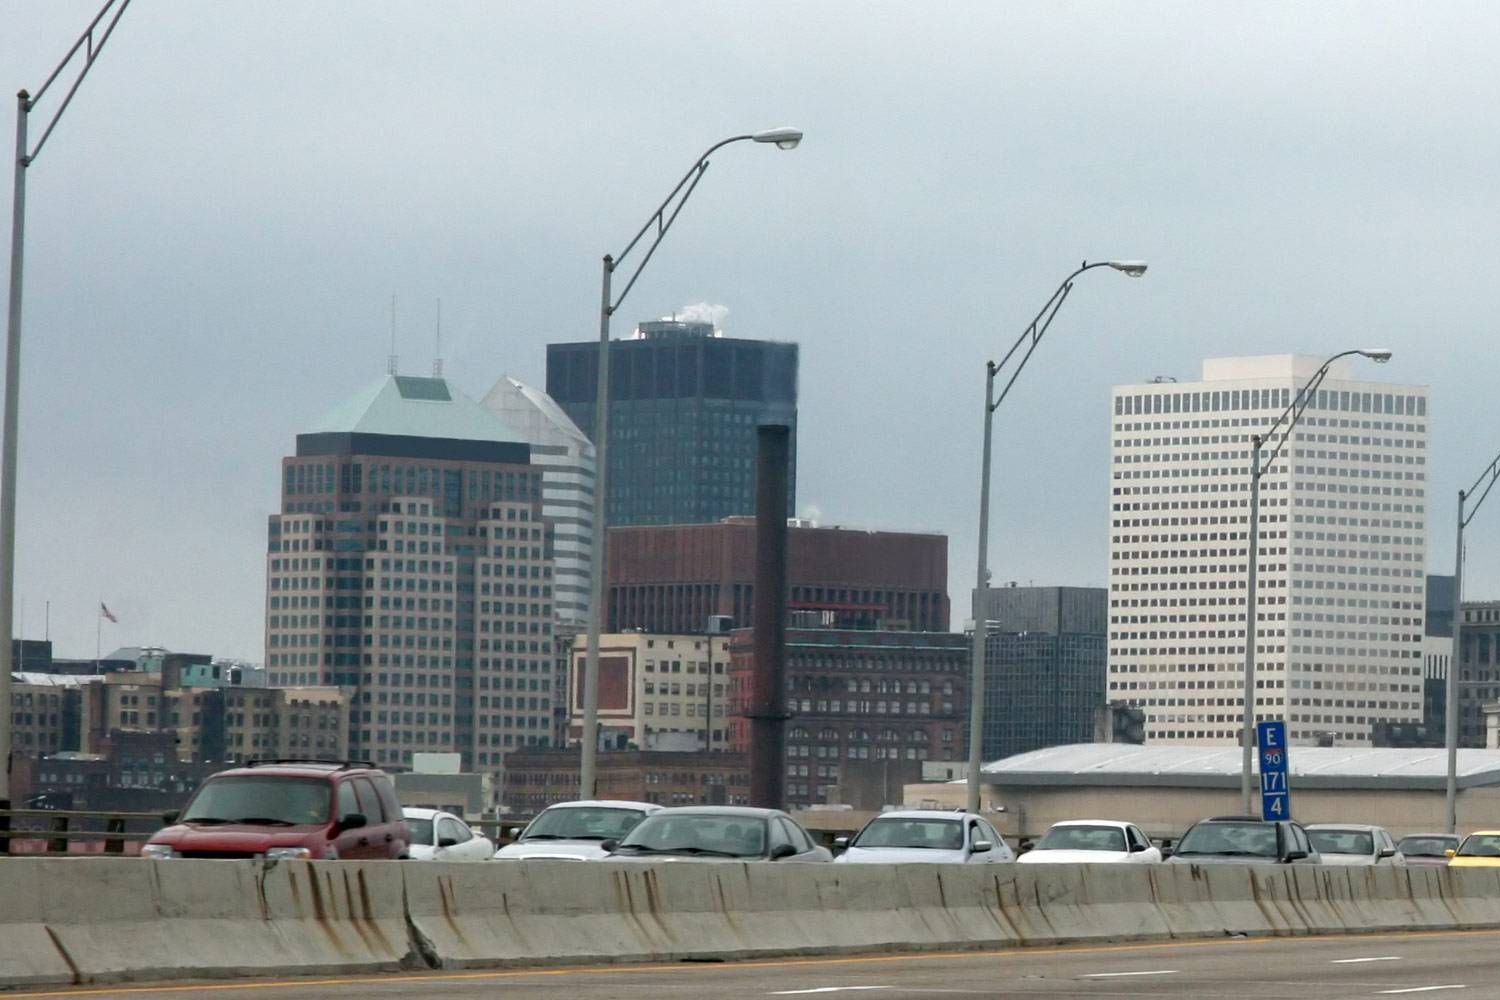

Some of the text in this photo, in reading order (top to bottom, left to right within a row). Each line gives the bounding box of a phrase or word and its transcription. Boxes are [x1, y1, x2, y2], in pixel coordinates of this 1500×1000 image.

[1266, 727, 1277, 746] E
[1265, 753, 1281, 764] 90
[1262, 771, 1286, 791] 171
[1270, 797, 1282, 815] 4
